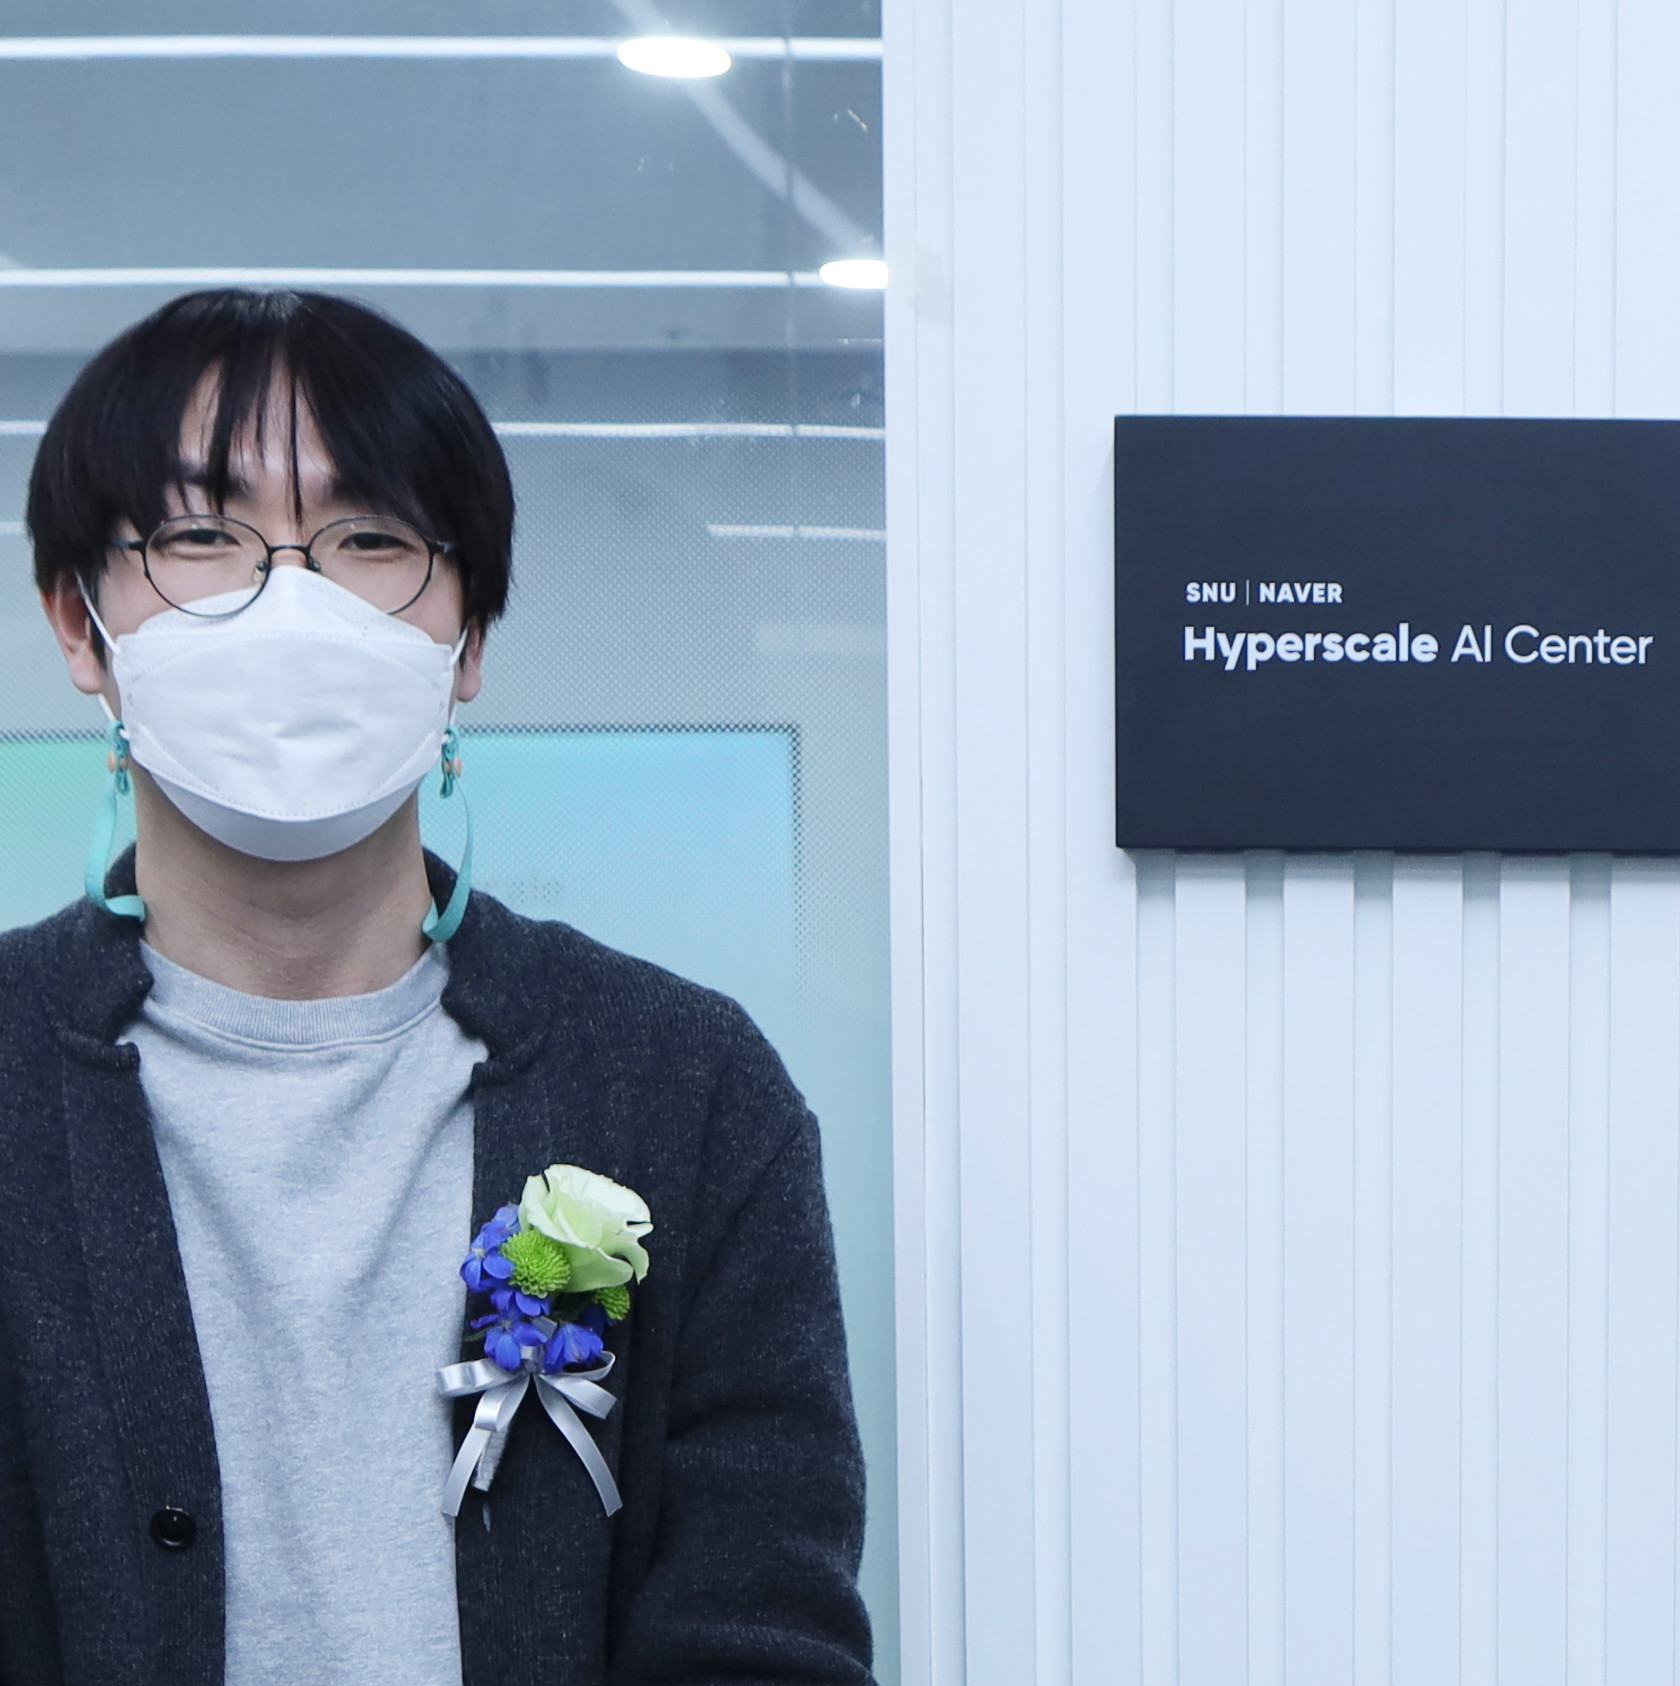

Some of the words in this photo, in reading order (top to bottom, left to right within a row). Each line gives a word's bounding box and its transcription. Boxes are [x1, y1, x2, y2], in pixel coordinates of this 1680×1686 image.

[1186, 581, 1236, 603] SNU
[1259, 582, 1343, 604] NAVER
[1184, 622, 1439, 671] Hyperscale
[1450, 624, 1492, 663] AI
[1504, 624, 1654, 665] Center
